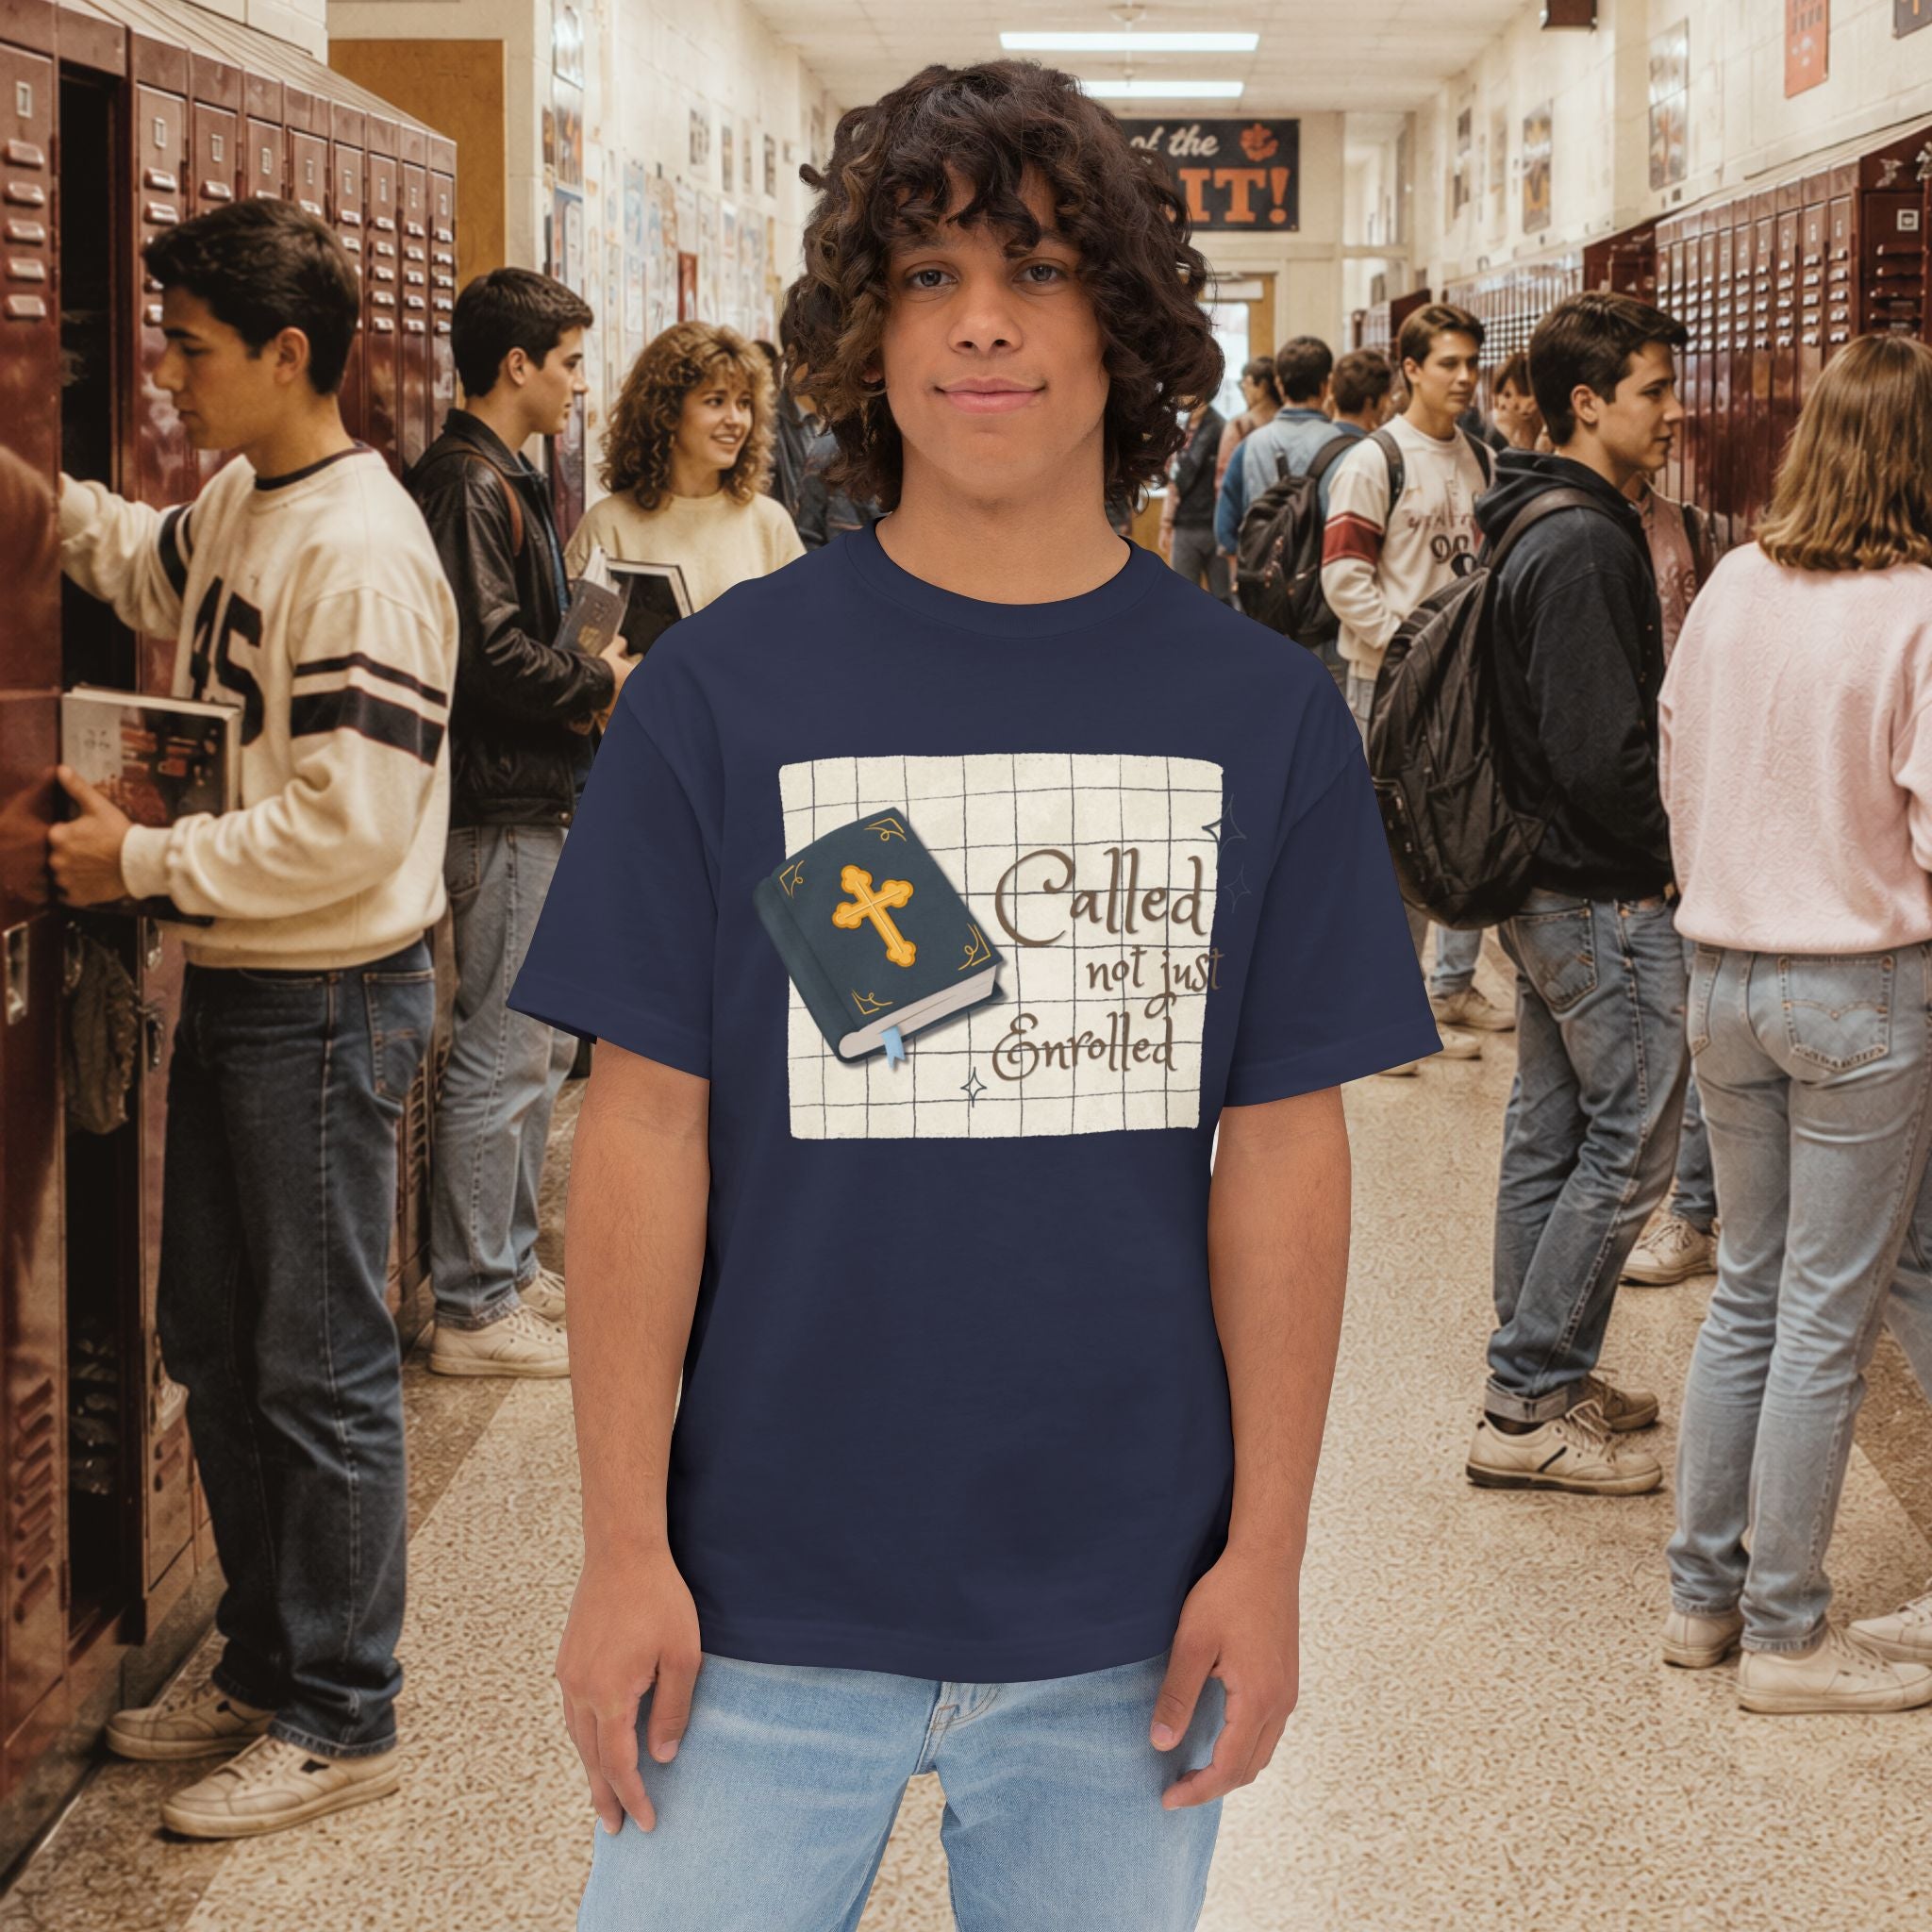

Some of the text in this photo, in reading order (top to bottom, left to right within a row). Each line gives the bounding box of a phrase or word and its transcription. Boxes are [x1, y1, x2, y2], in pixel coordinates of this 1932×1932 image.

[1168, 124, 1219, 157] the
[1160, 167, 1290, 223] IT!
[995, 847, 1208, 947] Called
[1086, 944, 1225, 1019] not just
[992, 1012, 1178, 1081] Enrolled
